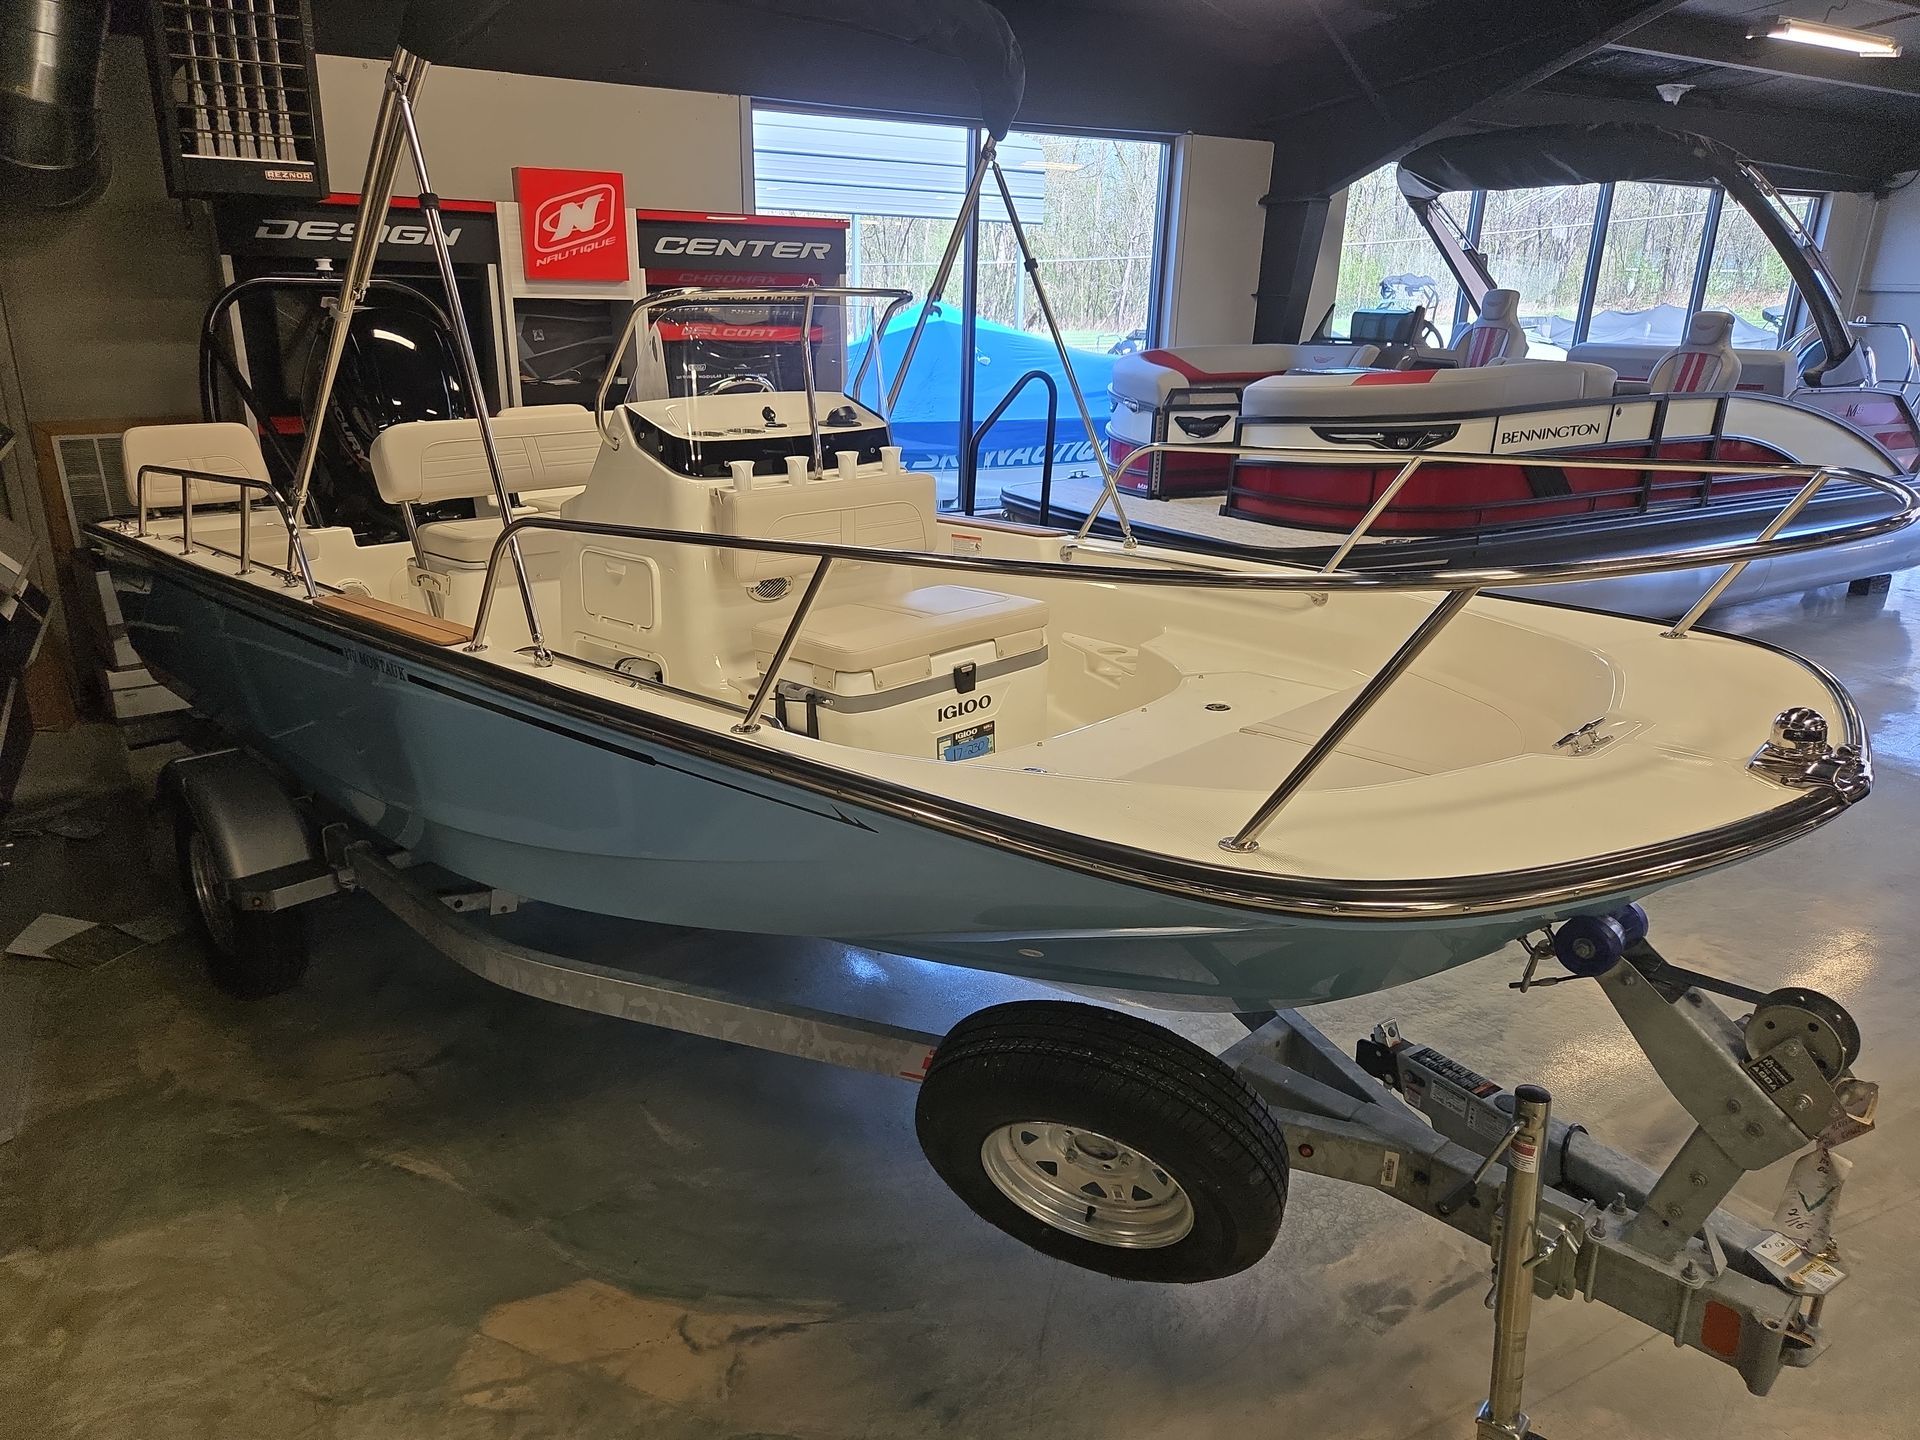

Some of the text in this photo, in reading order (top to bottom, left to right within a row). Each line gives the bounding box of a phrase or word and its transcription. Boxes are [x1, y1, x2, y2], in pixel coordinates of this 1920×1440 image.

[266, 170, 312, 181] REZNOR
[536, 236, 616, 267] NAUTIQUE
[654, 236, 832, 260] CENTER
[678, 272, 778, 285] CHROMAX
[1501, 422, 1601, 445] BENNINGTON
[937, 694, 992, 723] IGLOO
[955, 727, 978, 741] IGLOO
